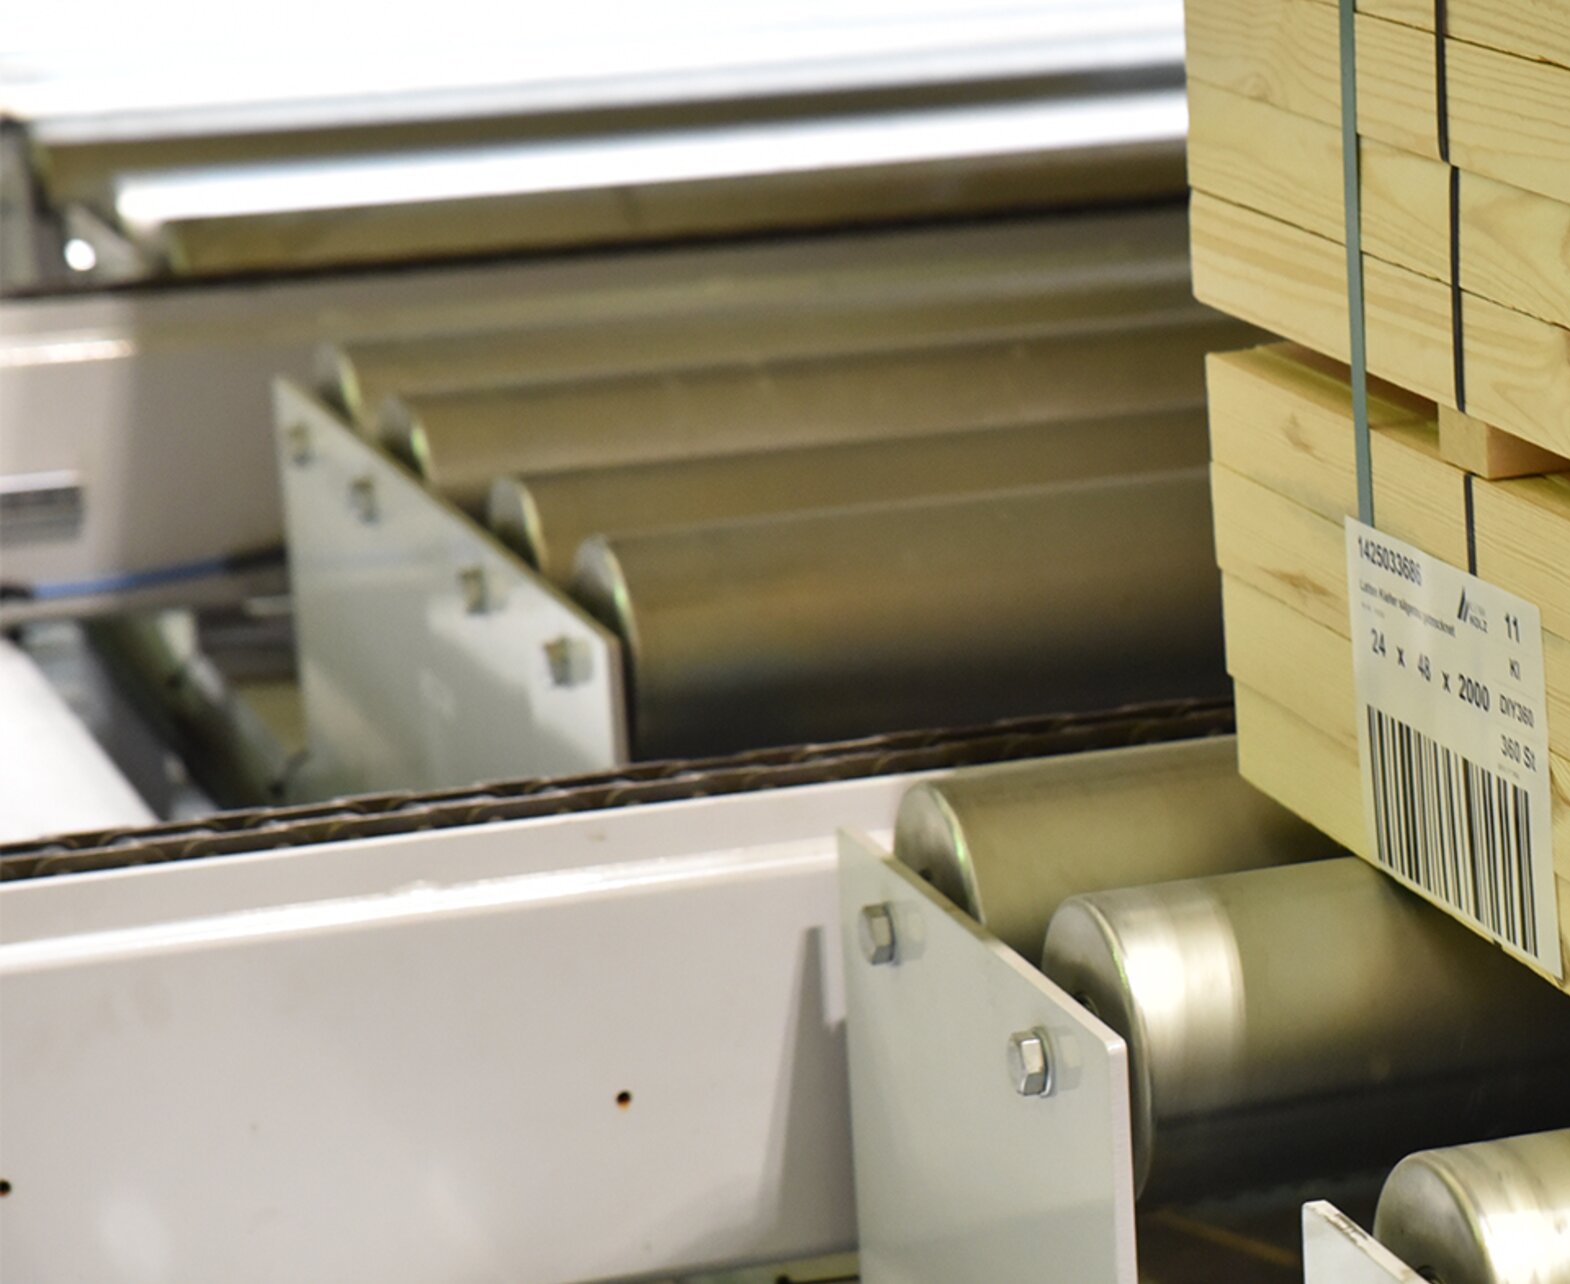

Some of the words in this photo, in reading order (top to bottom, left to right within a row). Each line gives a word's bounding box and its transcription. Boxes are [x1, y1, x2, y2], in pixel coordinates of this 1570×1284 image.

[1504, 611, 1520, 644] 11
[1371, 627, 1386, 657] 24
[1458, 673, 1490, 712] 2000
[1501, 733, 1521, 764] 360
